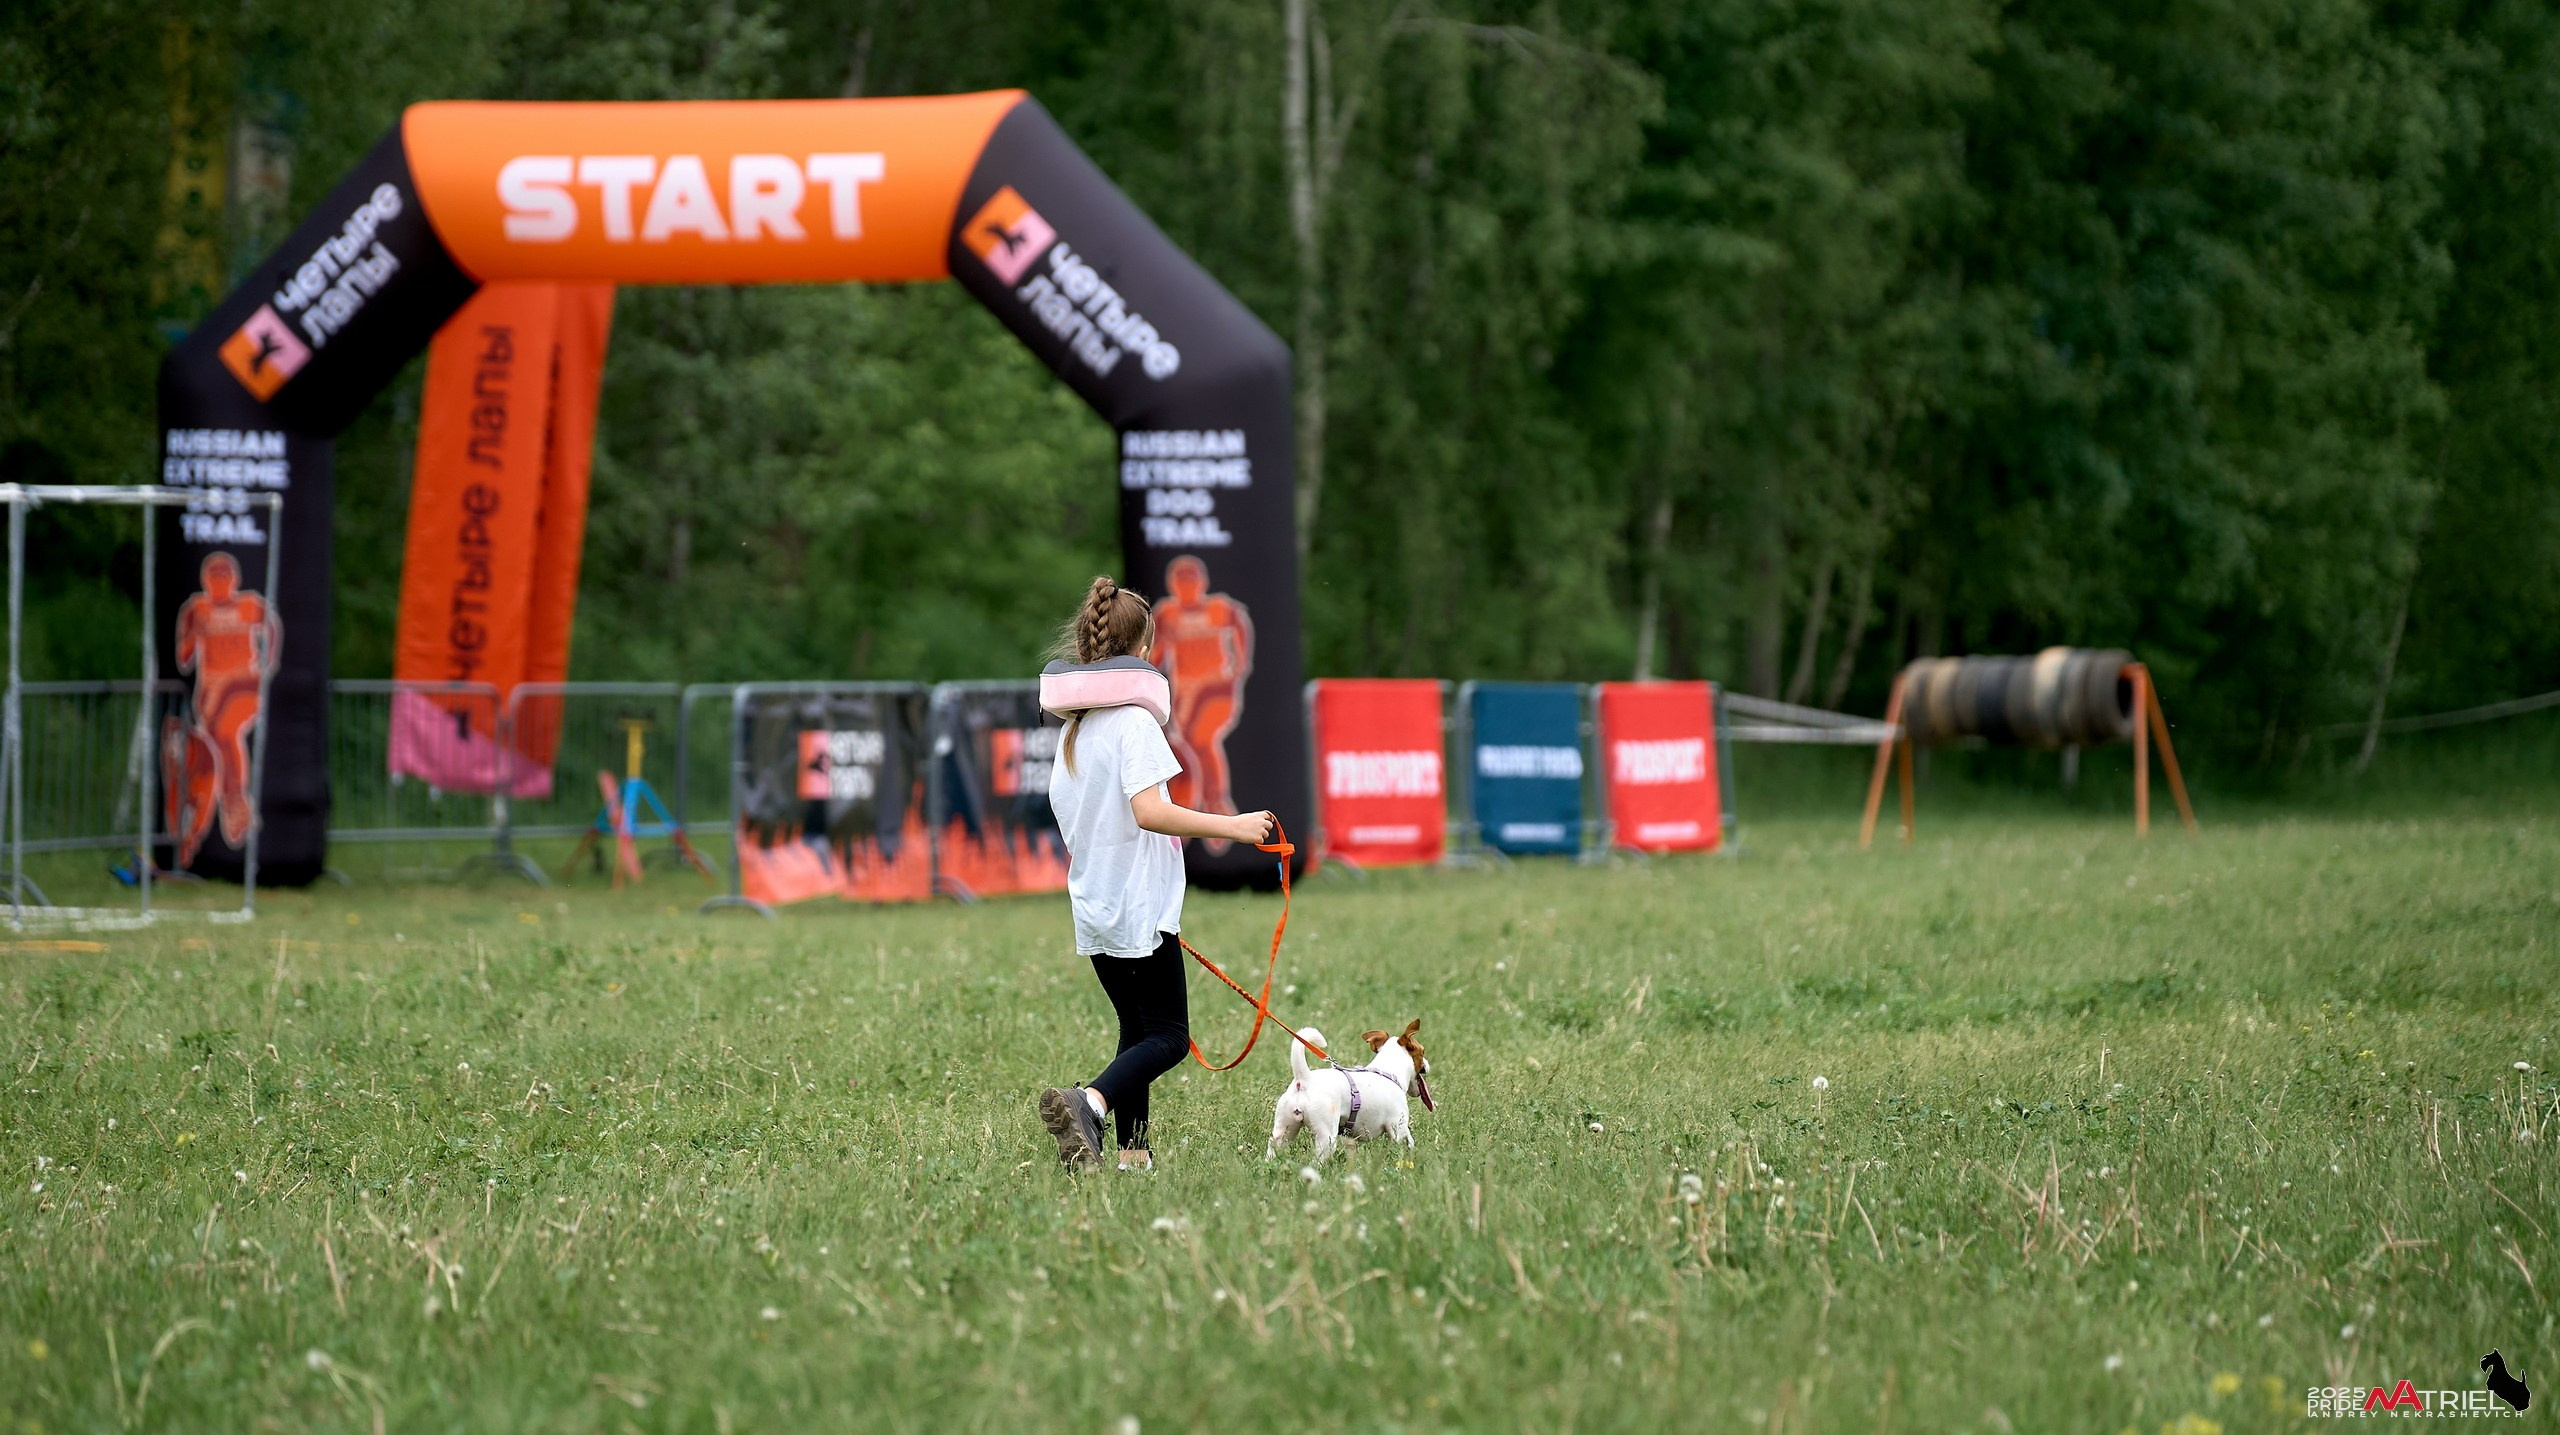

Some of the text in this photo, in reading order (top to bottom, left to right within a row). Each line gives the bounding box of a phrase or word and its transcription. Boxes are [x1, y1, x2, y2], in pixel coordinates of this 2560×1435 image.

[496, 153, 885, 242] START
[274, 183, 402, 311] четыре
[301, 242, 400, 347] лапы
[1017, 274, 1121, 377] лапы
[1049, 242, 1181, 380] четыре
[467, 326, 514, 471] лапы
[166, 429, 287, 458] RUSSIAN
[1122, 430, 1246, 458] RUSSIAN
[163, 457, 290, 488] EXTREME
[1121, 457, 1252, 488] EXTREME
[1146, 487, 1215, 516] DOG
[179, 513, 267, 544] TRAIL
[1140, 517, 1233, 546] TRAIL
